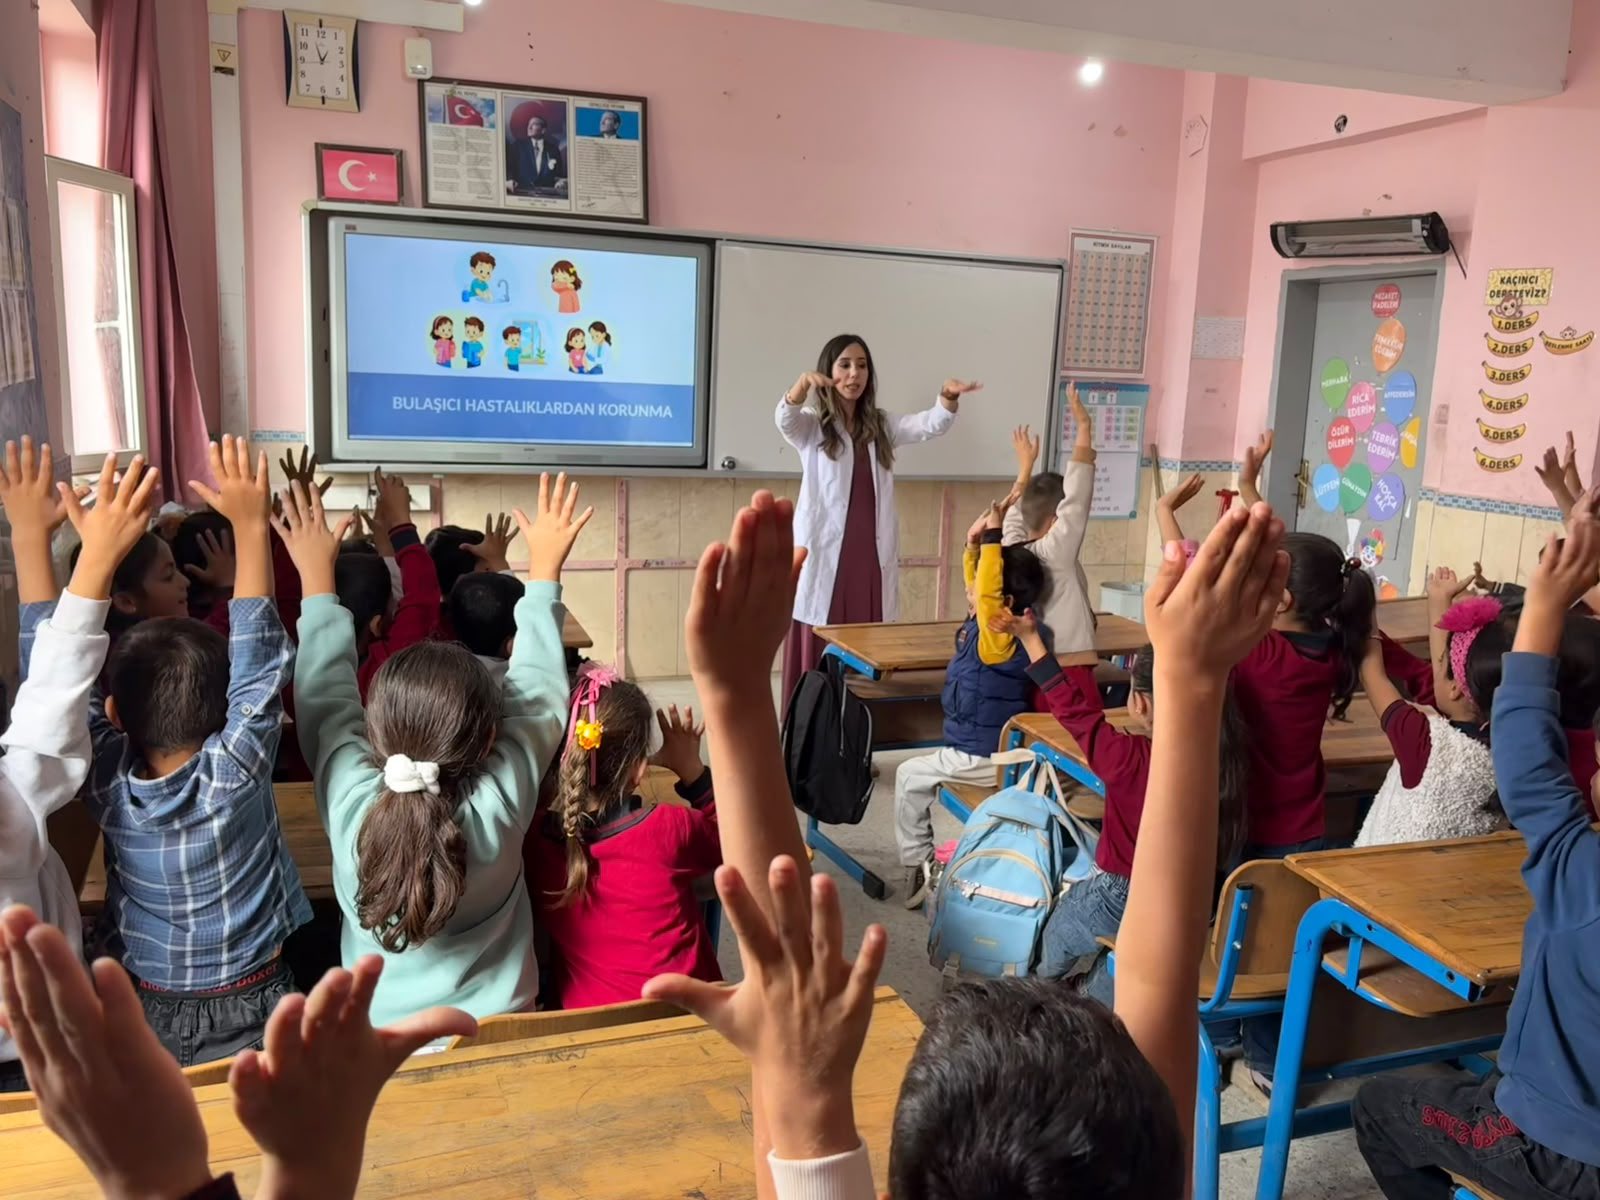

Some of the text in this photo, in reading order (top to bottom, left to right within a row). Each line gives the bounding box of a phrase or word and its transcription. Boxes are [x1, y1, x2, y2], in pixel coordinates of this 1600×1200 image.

[301, 28, 309, 37] 11
[316, 30, 326, 39] 12
[334, 31, 338, 40] 1
[300, 41, 308, 50] 10
[338, 46, 344, 54] 2
[299, 56, 305, 64] 9
[339, 60, 344, 69] 3
[300, 70, 306, 78] 8
[339, 74, 344, 82] 4
[305, 84, 311, 92] 7
[320, 86, 326, 94] 6
[335, 87, 341, 96] 5
[1499, 275, 1539, 287] KAÇINCI
[1497, 317, 1532, 331] 1.DERS
[1492, 342, 1528, 354] 2.DERS
[1490, 369, 1525, 382] 3.DERS
[1351, 392, 1370, 404] RİCA
[392, 396, 674, 419] BULAŞICI HASTALIKLARDAN KORUNMA
[1347, 403, 1376, 418] EDERİM
[1486, 398, 1523, 411] 4.DERS
[1330, 424, 1350, 436] ÖZÜR
[1483, 428, 1520, 441] 5.DERS
[1327, 436, 1354, 450] DİLERİM
[1371, 430, 1399, 447] TEBRİK
[1367, 442, 1396, 460] EDERİM
[1480, 457, 1516, 470] 6.DERS
[1314, 477, 1340, 498] LÜTFEN
